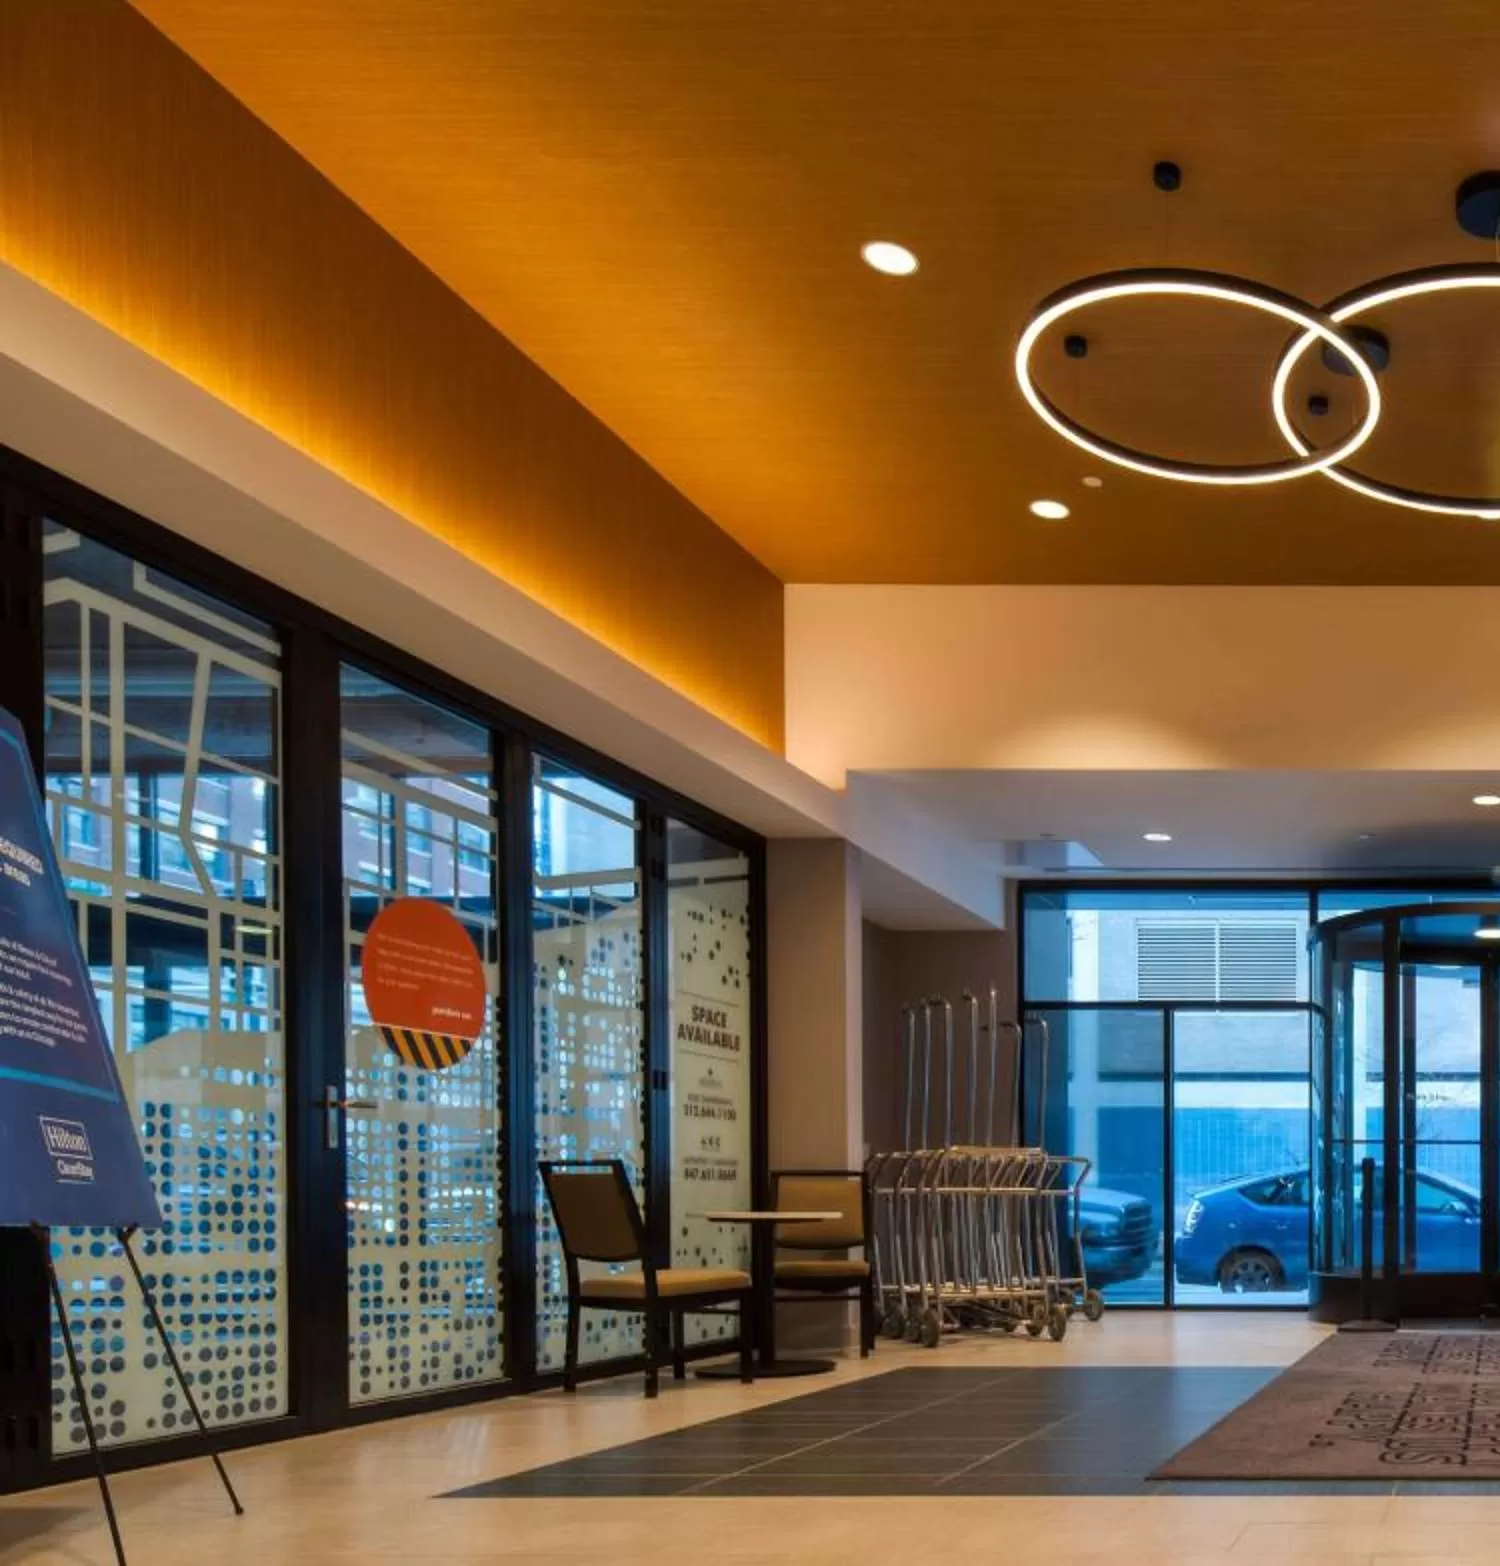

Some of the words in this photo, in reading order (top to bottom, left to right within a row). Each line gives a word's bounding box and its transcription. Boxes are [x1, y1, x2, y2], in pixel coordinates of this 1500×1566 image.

[691, 1005, 727, 1029] SPACE
[677, 1023, 741, 1052] AVAILABLE
[45, 1124, 87, 1152] Hilton
